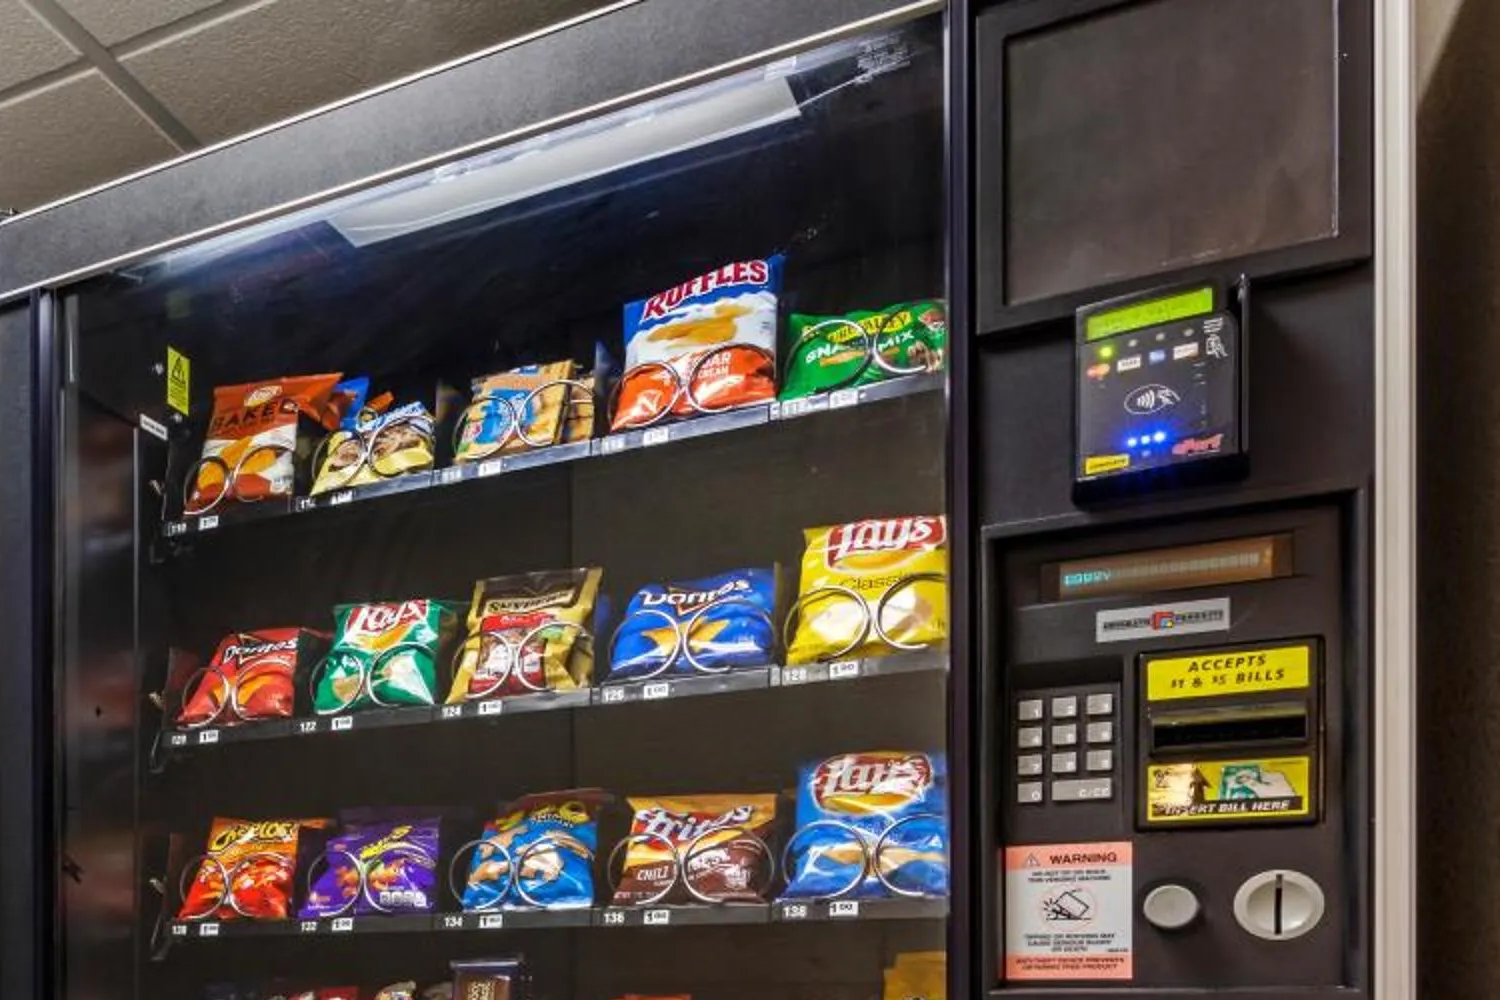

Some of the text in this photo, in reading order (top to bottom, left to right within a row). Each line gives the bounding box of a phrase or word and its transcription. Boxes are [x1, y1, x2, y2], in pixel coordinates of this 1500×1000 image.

[643, 259, 768, 319] RUFFLES
[641, 579, 750, 606] Doritos
[1187, 654, 1267, 673] ACCEPTS
[1235, 668, 1285, 684] BILLS
[1217, 802, 1249, 813] BILL
[1251, 799, 1290, 811] HERE
[1049, 851, 1117, 865] WARNING
